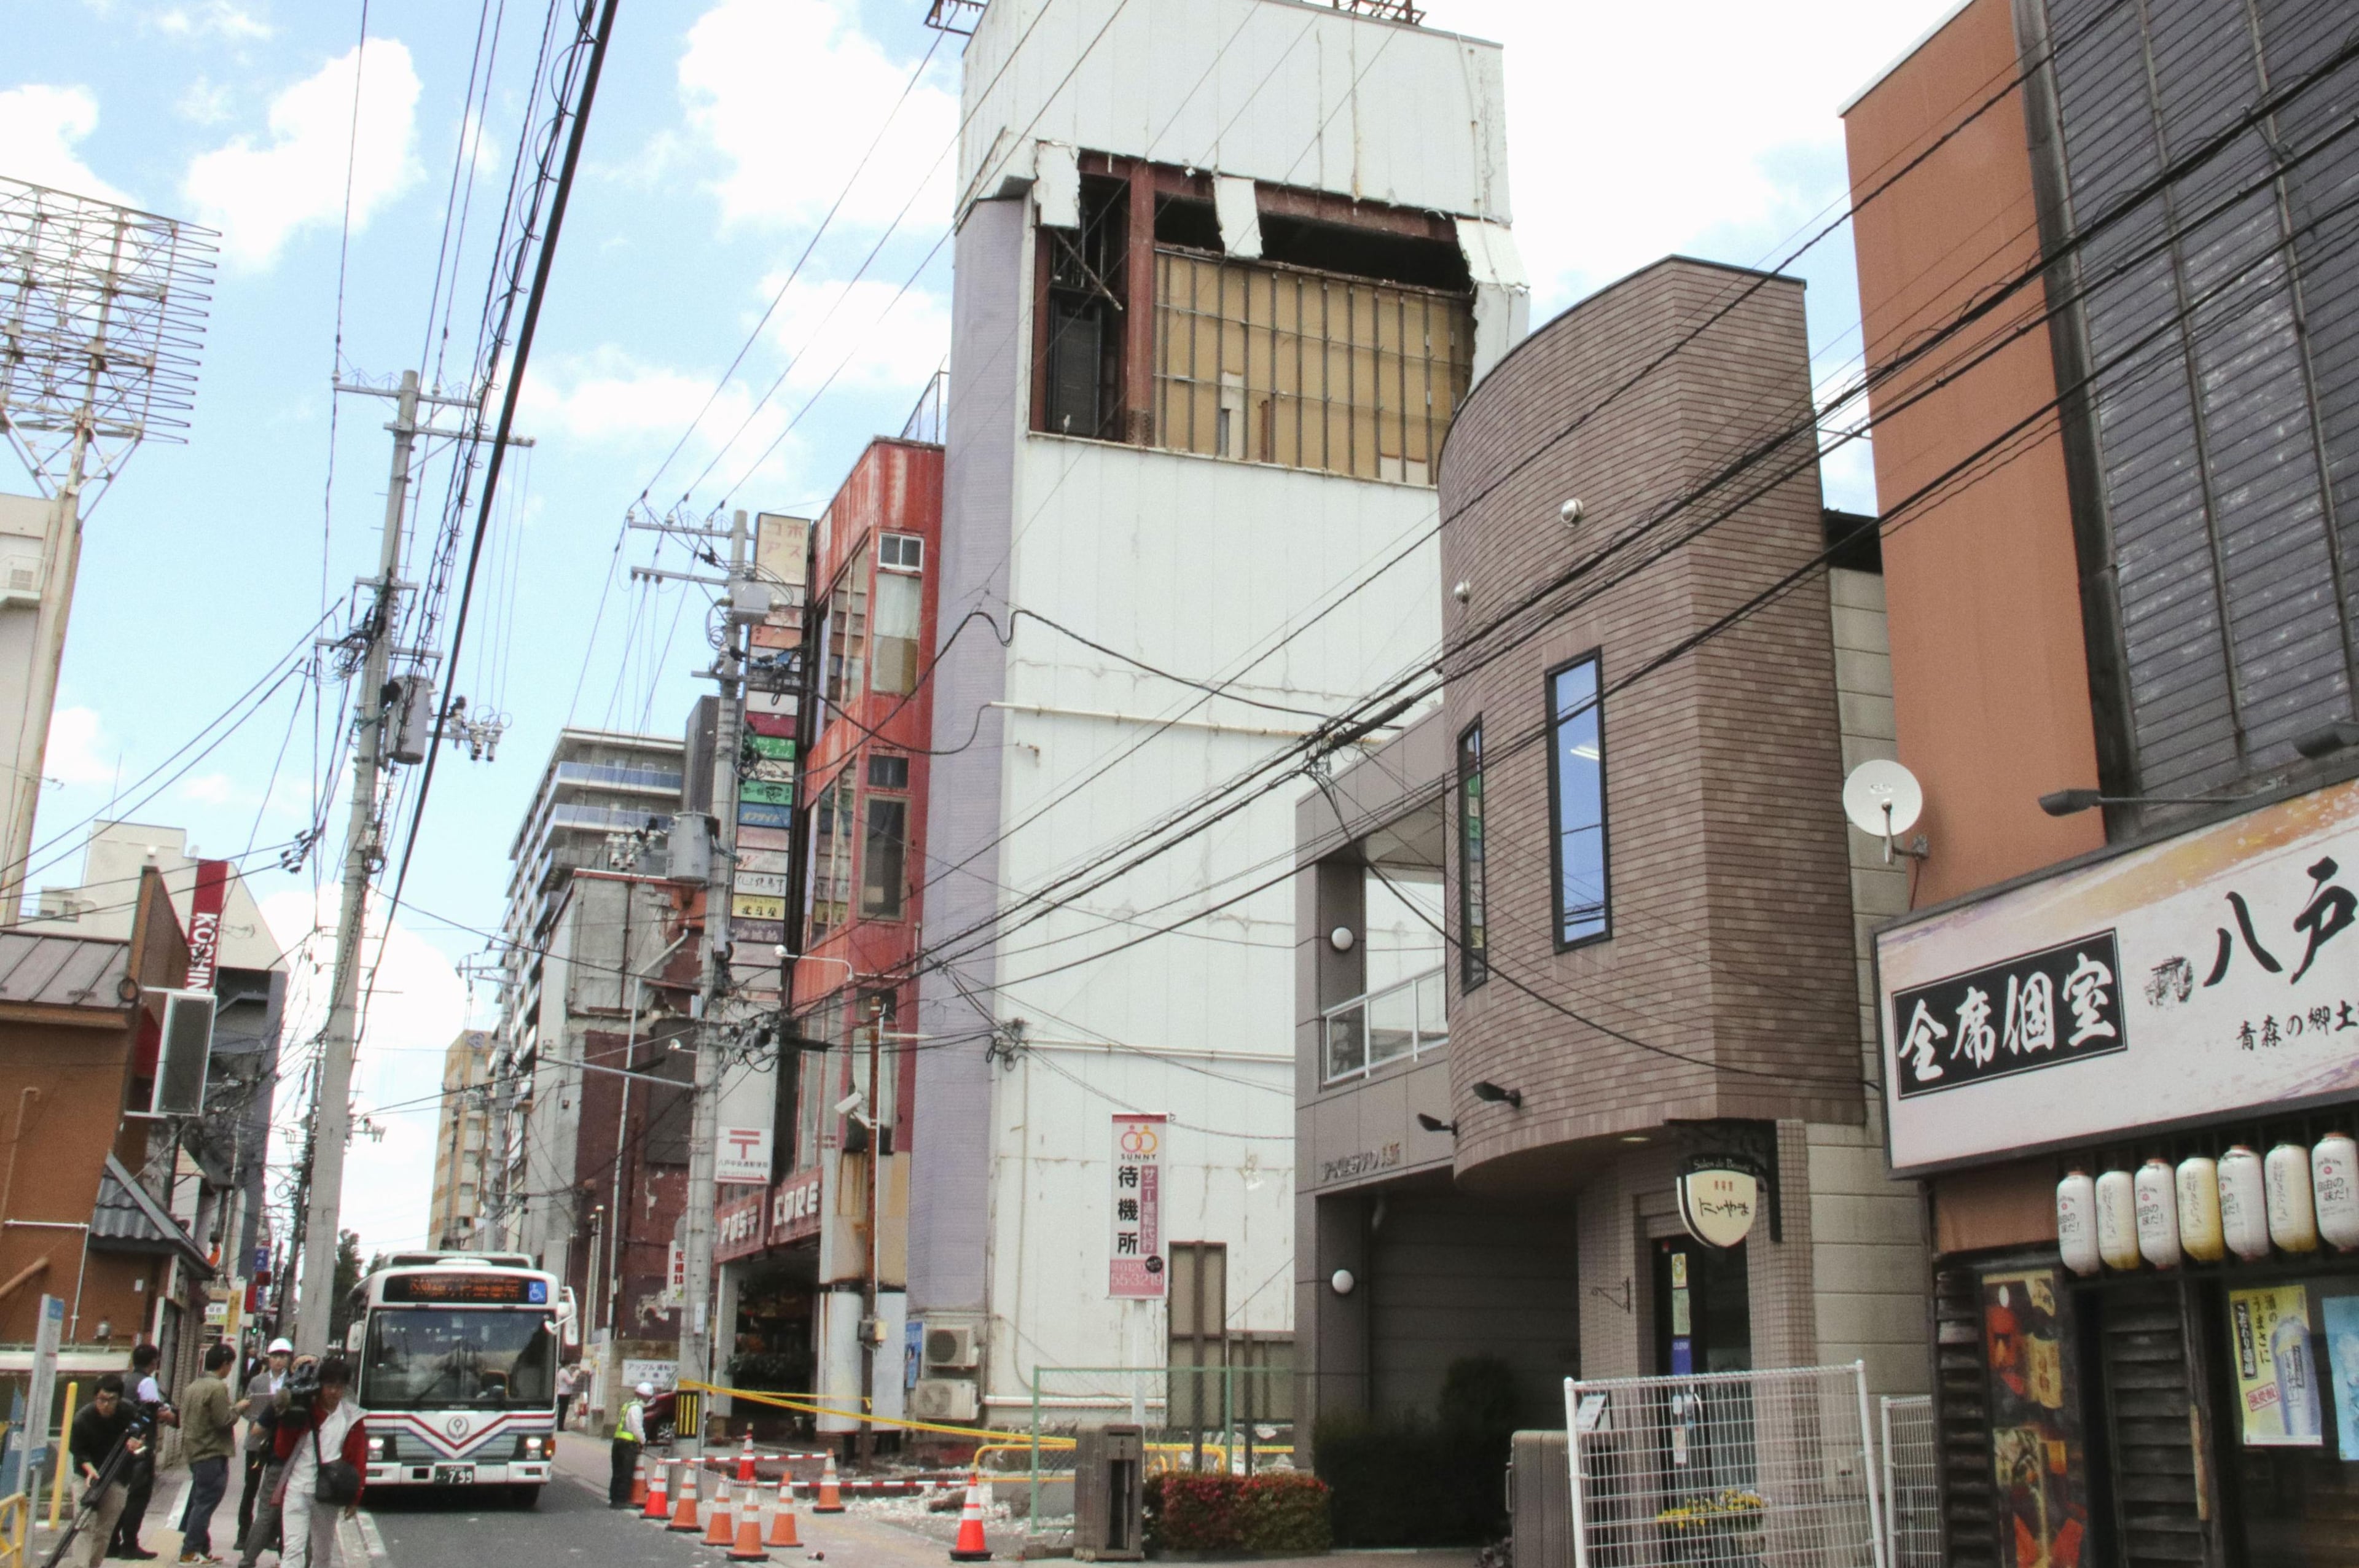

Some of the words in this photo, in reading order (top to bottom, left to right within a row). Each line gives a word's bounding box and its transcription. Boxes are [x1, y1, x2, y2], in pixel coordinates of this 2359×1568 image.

[186, 913, 218, 993] KOSHIN
[2203, 856, 2359, 987] 八戸
[1898, 953, 2118, 1082] 全席個室
[2237, 999, 2359, 1051] 青森の郷土
[774, 1180, 819, 1227] CORE
[1117, 1166, 1138, 1255] 待機所
